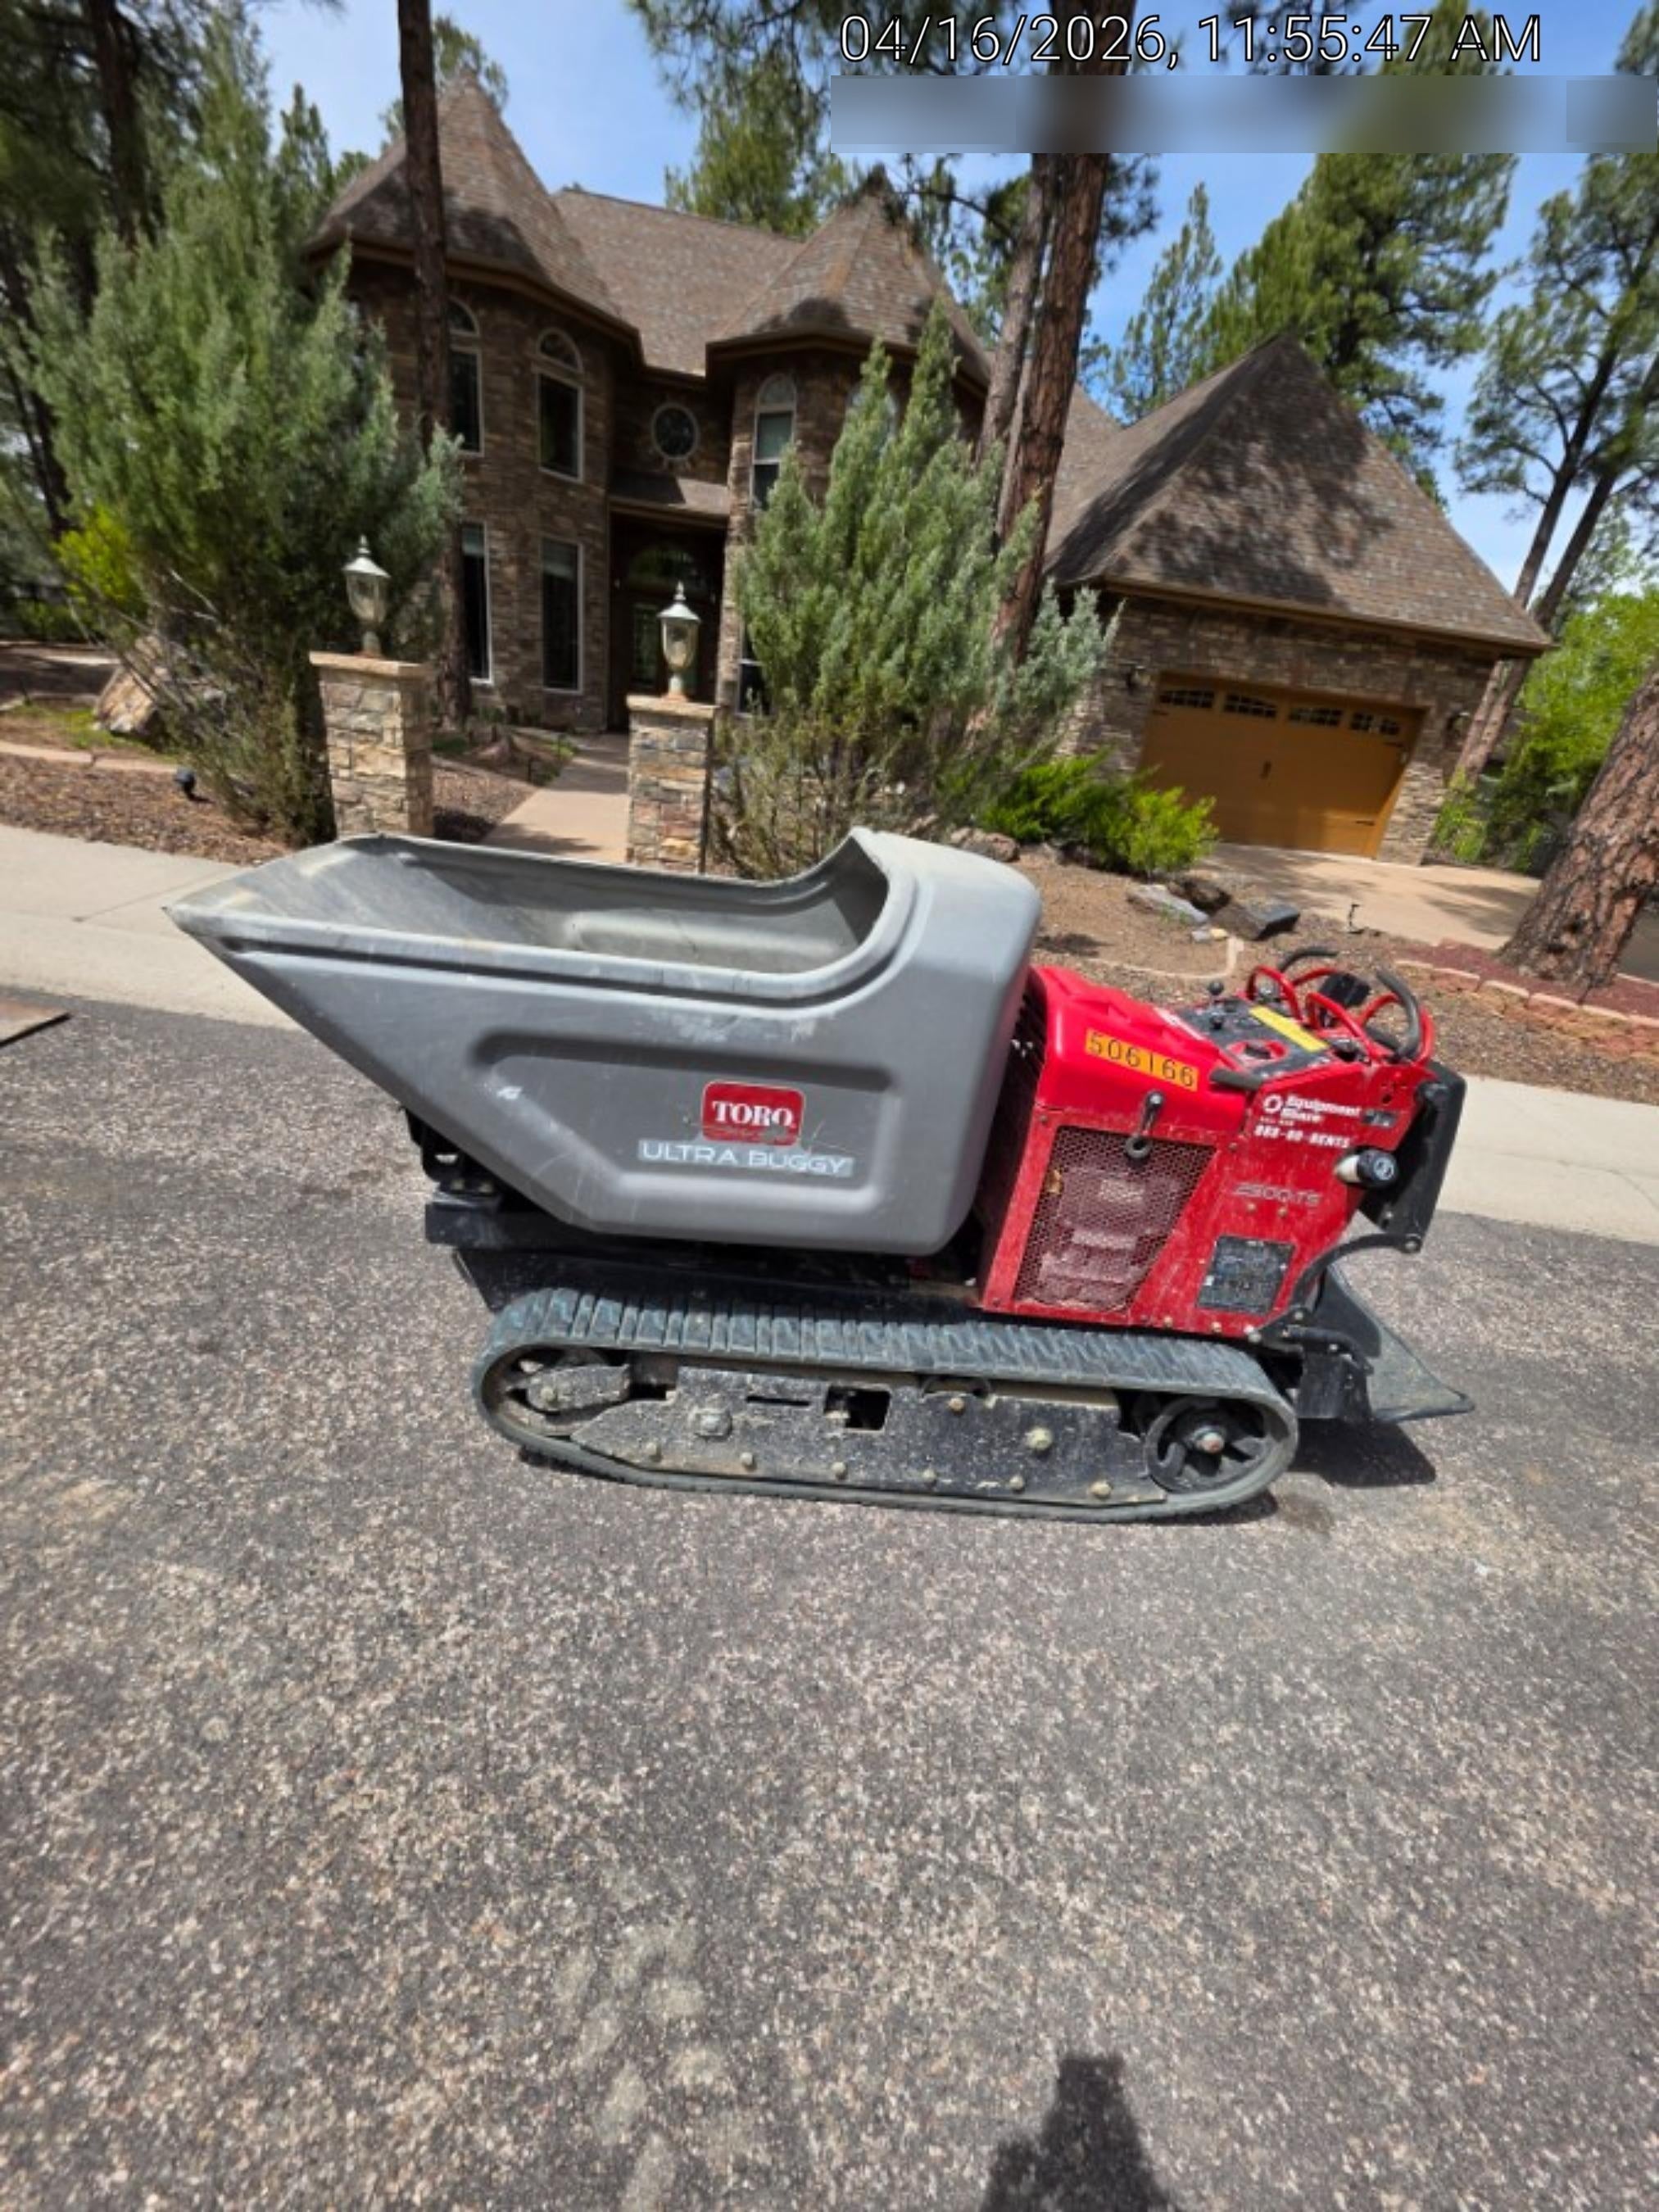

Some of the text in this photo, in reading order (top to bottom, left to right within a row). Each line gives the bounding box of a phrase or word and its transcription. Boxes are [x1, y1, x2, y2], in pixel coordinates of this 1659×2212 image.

[1090, 1031, 1194, 1088] 506166
[711, 1100, 793, 1128] TORO
[1285, 1094, 1362, 1117] Equipment
[641, 1141, 847, 1174] ULTRA BUGGY
